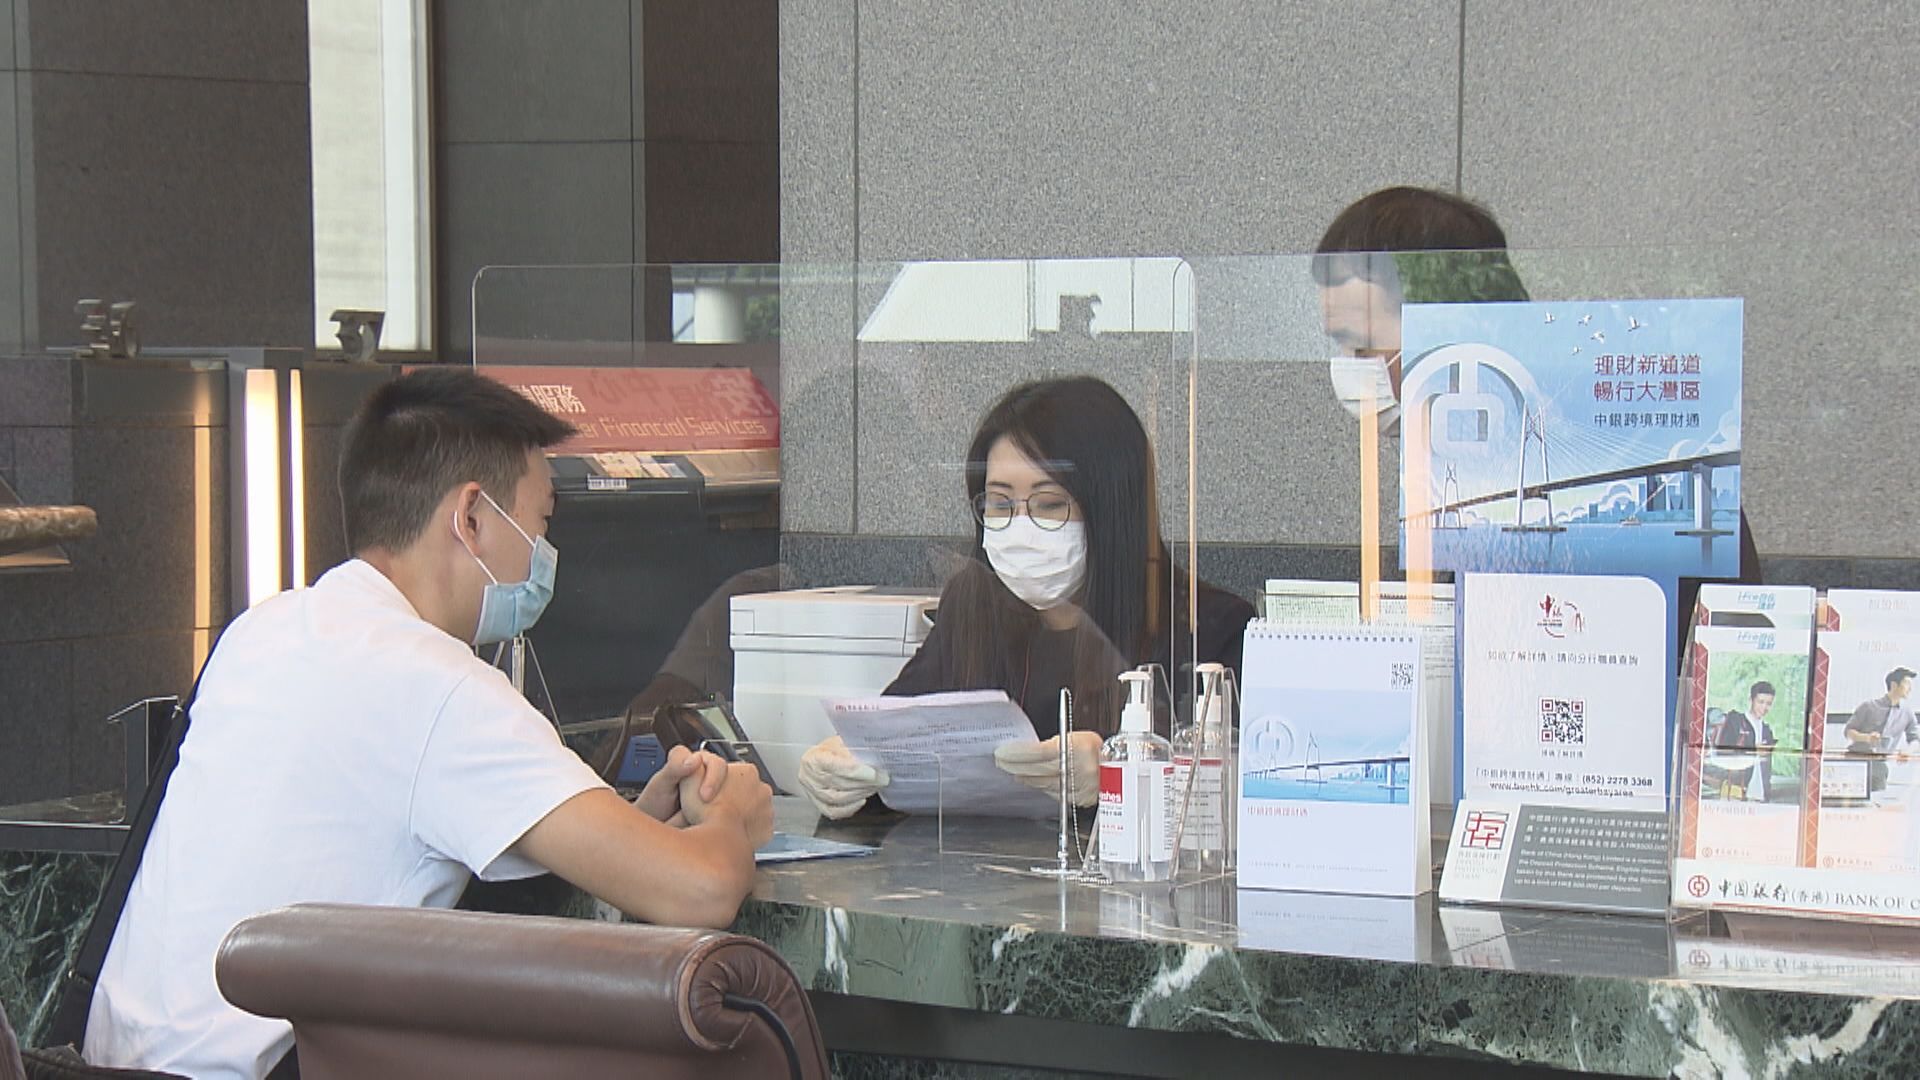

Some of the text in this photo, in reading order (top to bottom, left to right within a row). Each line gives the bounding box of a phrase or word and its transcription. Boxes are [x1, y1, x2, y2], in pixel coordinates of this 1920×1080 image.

[1594, 354, 1701, 376] 理財新通道
[518, 384, 586, 413] 服務
[1594, 381, 1700, 402] 暢行大灣區
[601, 416, 688, 438] Financial
[686, 415, 767, 436] Services
[1594, 412, 1699, 429] 中銀跨境理財通
[1582, 774, 1605, 786] (852)
[1607, 776, 1629, 786] 2278
[1835, 893, 1879, 907] BANK
[1884, 896, 1904, 909] OF
